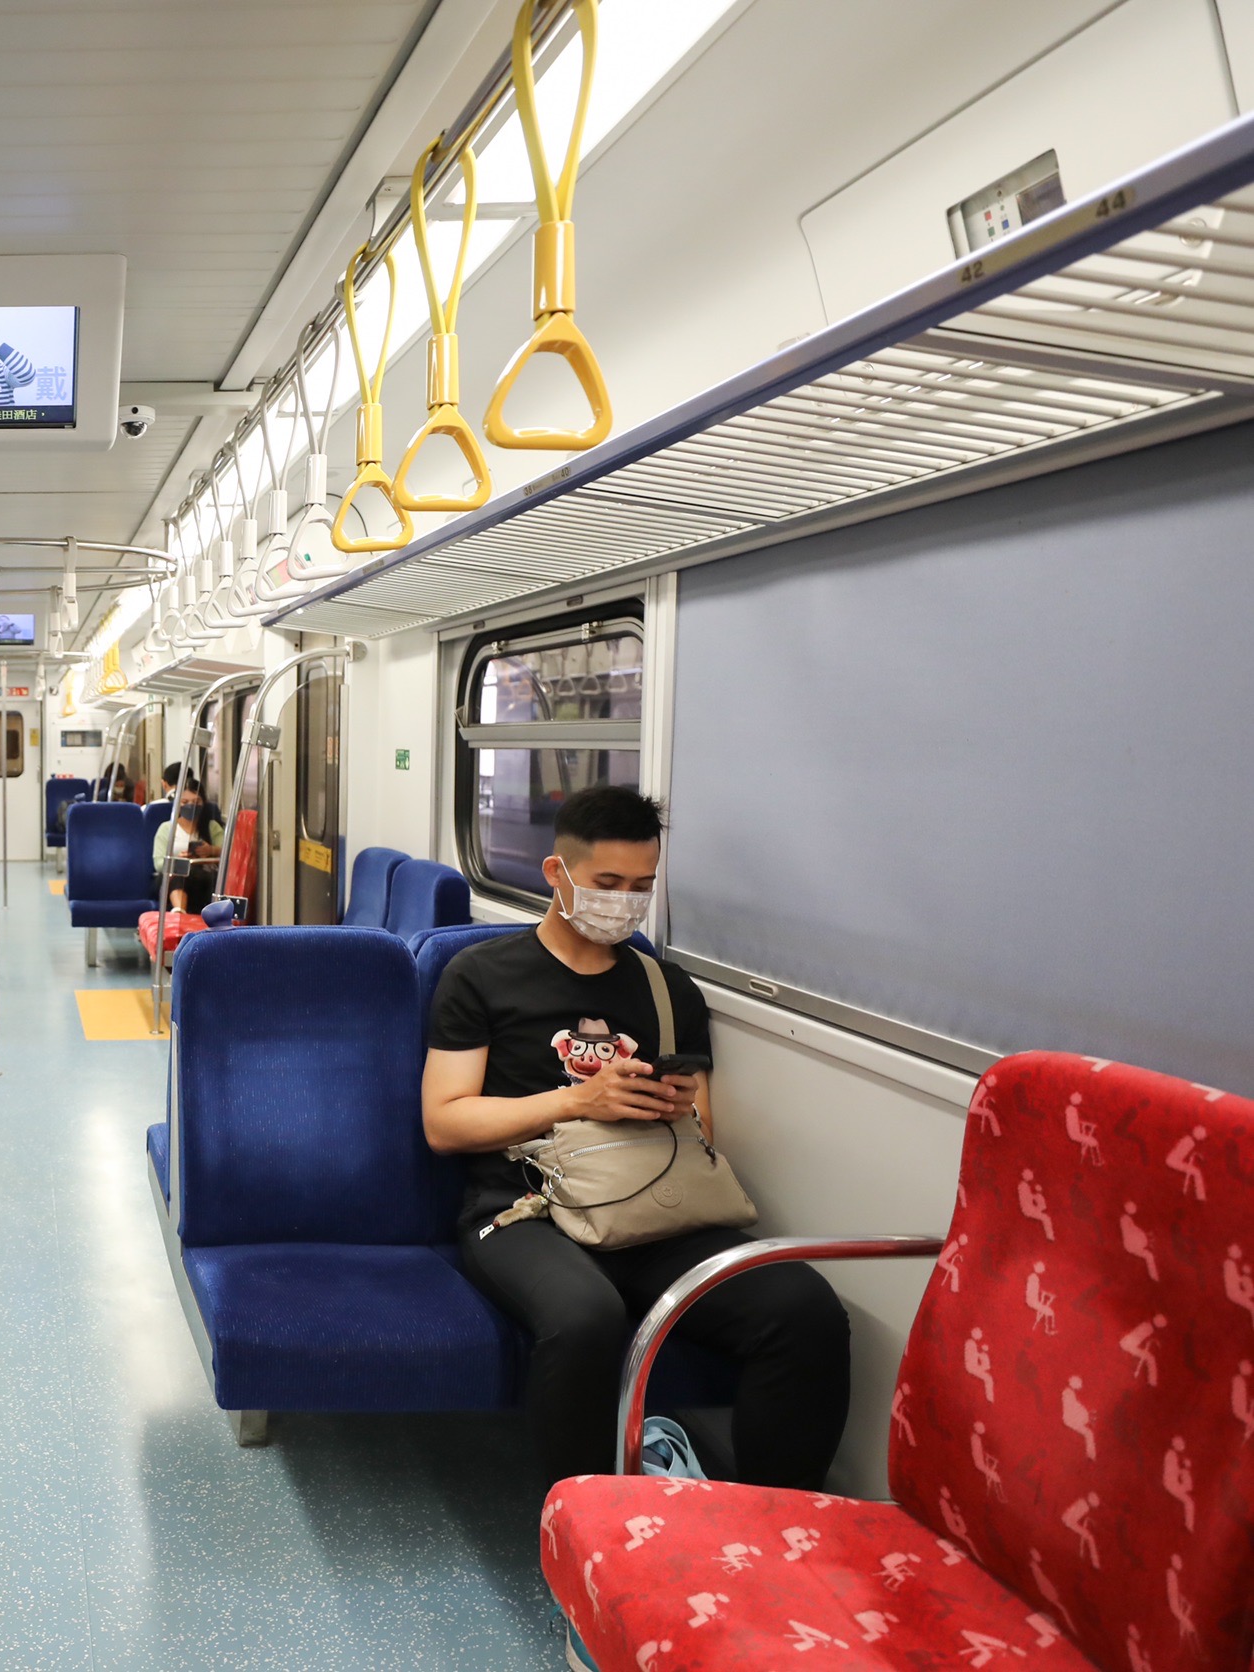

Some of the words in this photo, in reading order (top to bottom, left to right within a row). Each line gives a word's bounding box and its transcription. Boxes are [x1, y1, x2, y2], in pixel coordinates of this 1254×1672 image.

[1096, 190, 1126, 217] 44
[961, 261, 984, 283] 42
[35, 366, 67, 401] 戴
